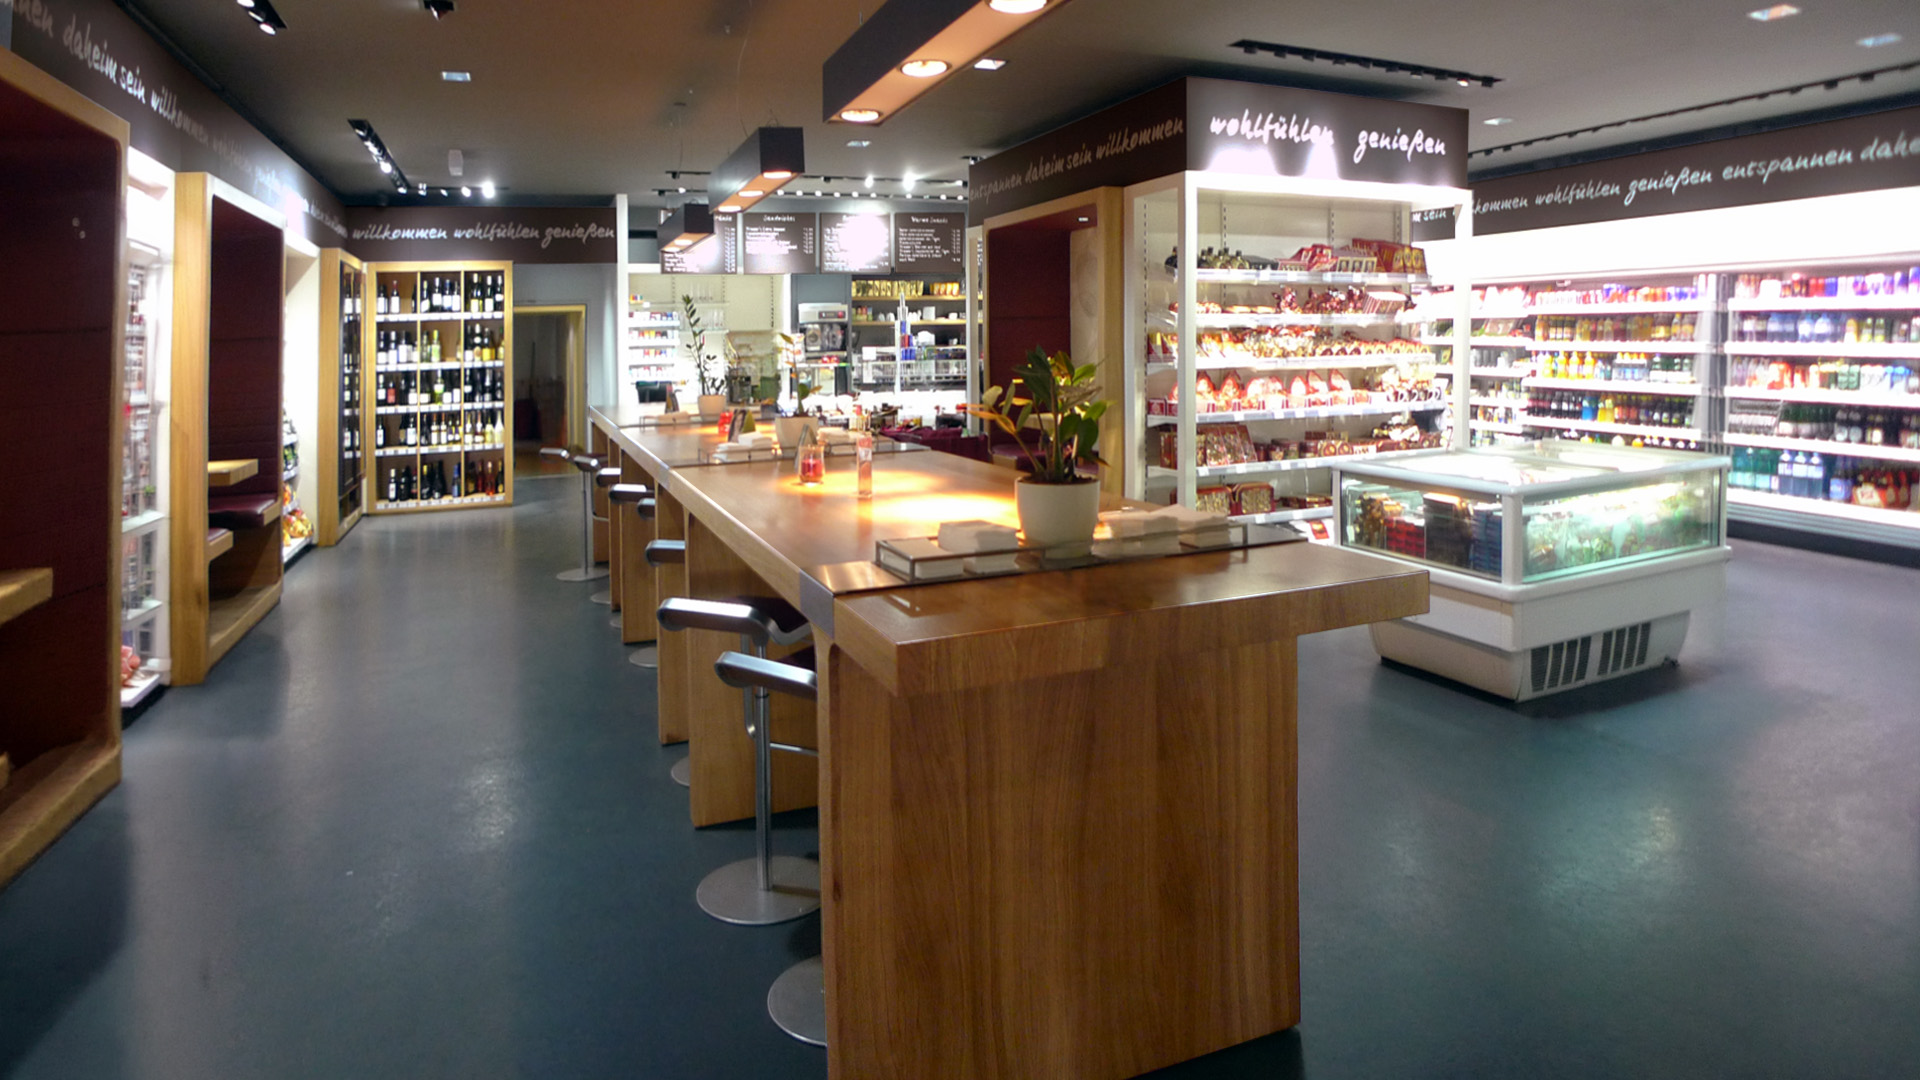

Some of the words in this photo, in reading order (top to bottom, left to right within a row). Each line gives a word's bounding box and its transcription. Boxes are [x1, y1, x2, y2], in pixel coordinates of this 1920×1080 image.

[63, 14, 117, 84] daheim
[120, 65, 146, 104] sein
[970, 168, 1022, 205] entspannen
[1025, 152, 1064, 185] daheim
[1066, 143, 1092, 170] sein
[1096, 117, 1184, 160] willkommen
[1210, 109, 1334, 145] wohlfühlen
[1353, 127, 1446, 164] genießen
[1423, 207, 1446, 221] sein
[1535, 180, 1621, 205] wohlfühlen
[1624, 166, 1712, 206] genießen
[1722, 147, 1853, 184] entspannen
[353, 223, 448, 241] willkommen
[453, 222, 540, 241] wohlfühlen
[545, 222, 615, 248] genießen
